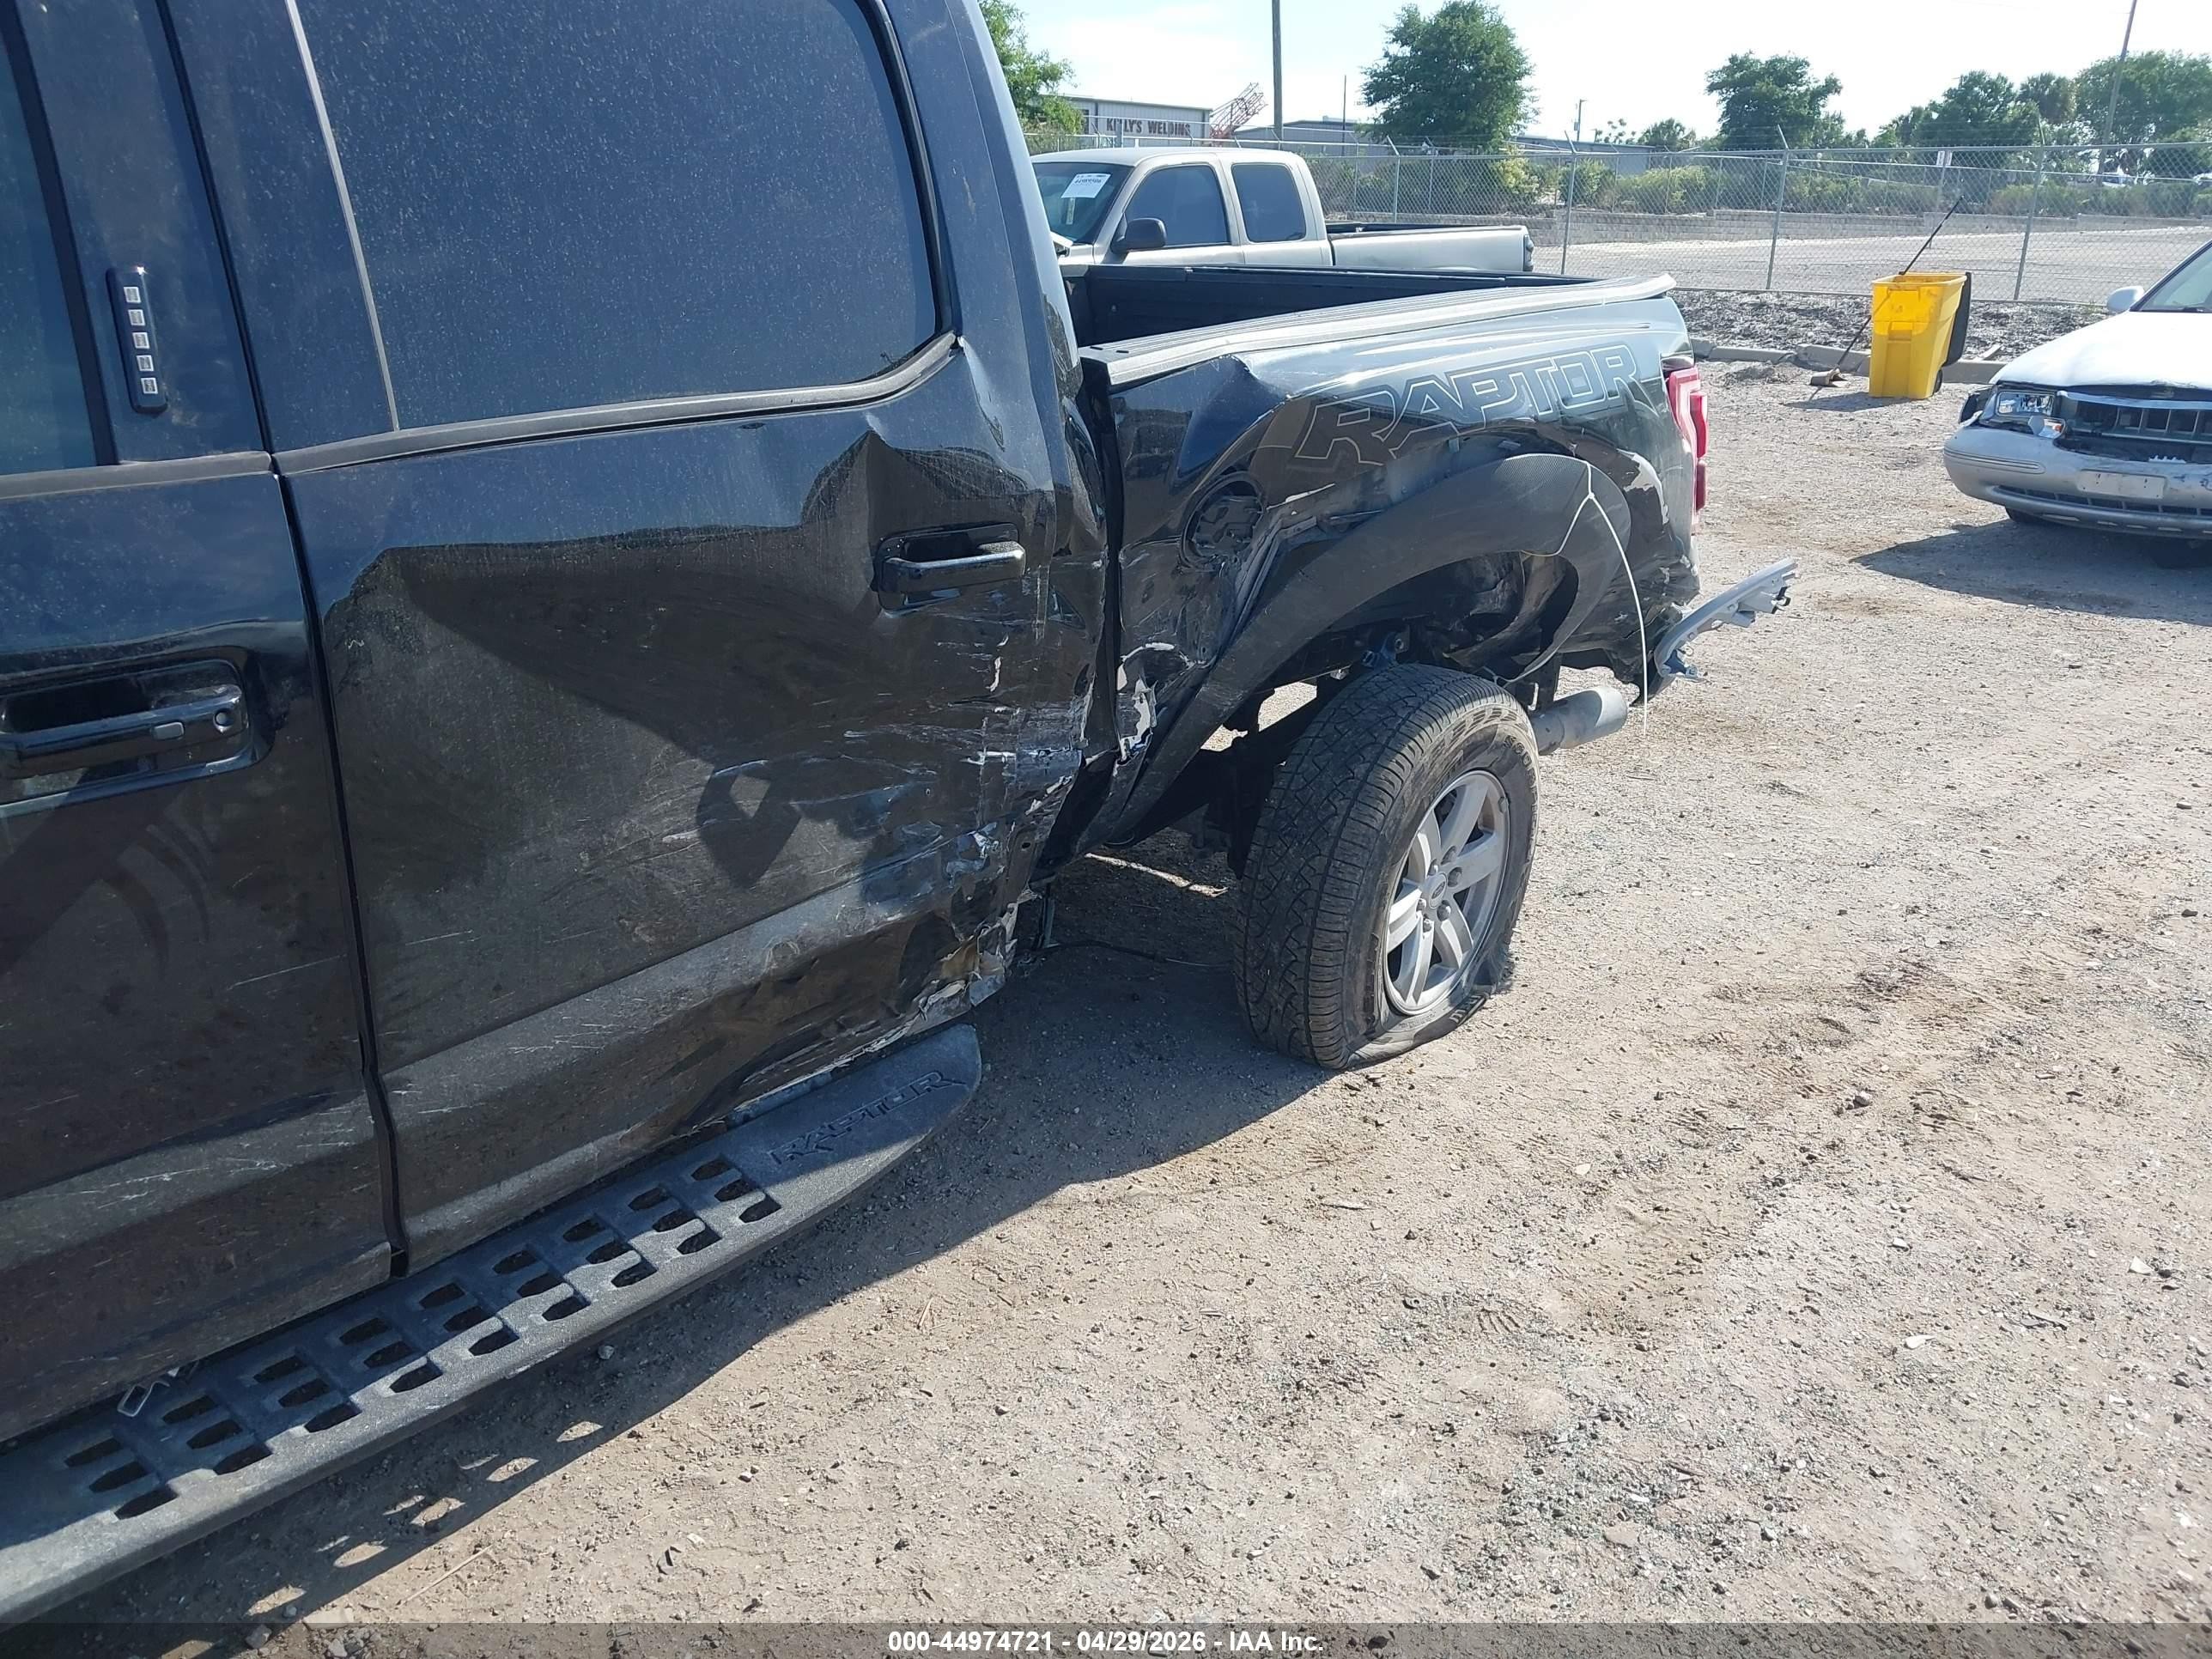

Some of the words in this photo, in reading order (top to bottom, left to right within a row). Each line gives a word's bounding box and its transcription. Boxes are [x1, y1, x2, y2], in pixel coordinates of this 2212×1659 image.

[1147, 120, 1191, 137] WELDING
[1294, 344, 1660, 467] RAPTOR
[767, 1070, 967, 1164] RAPTOR
